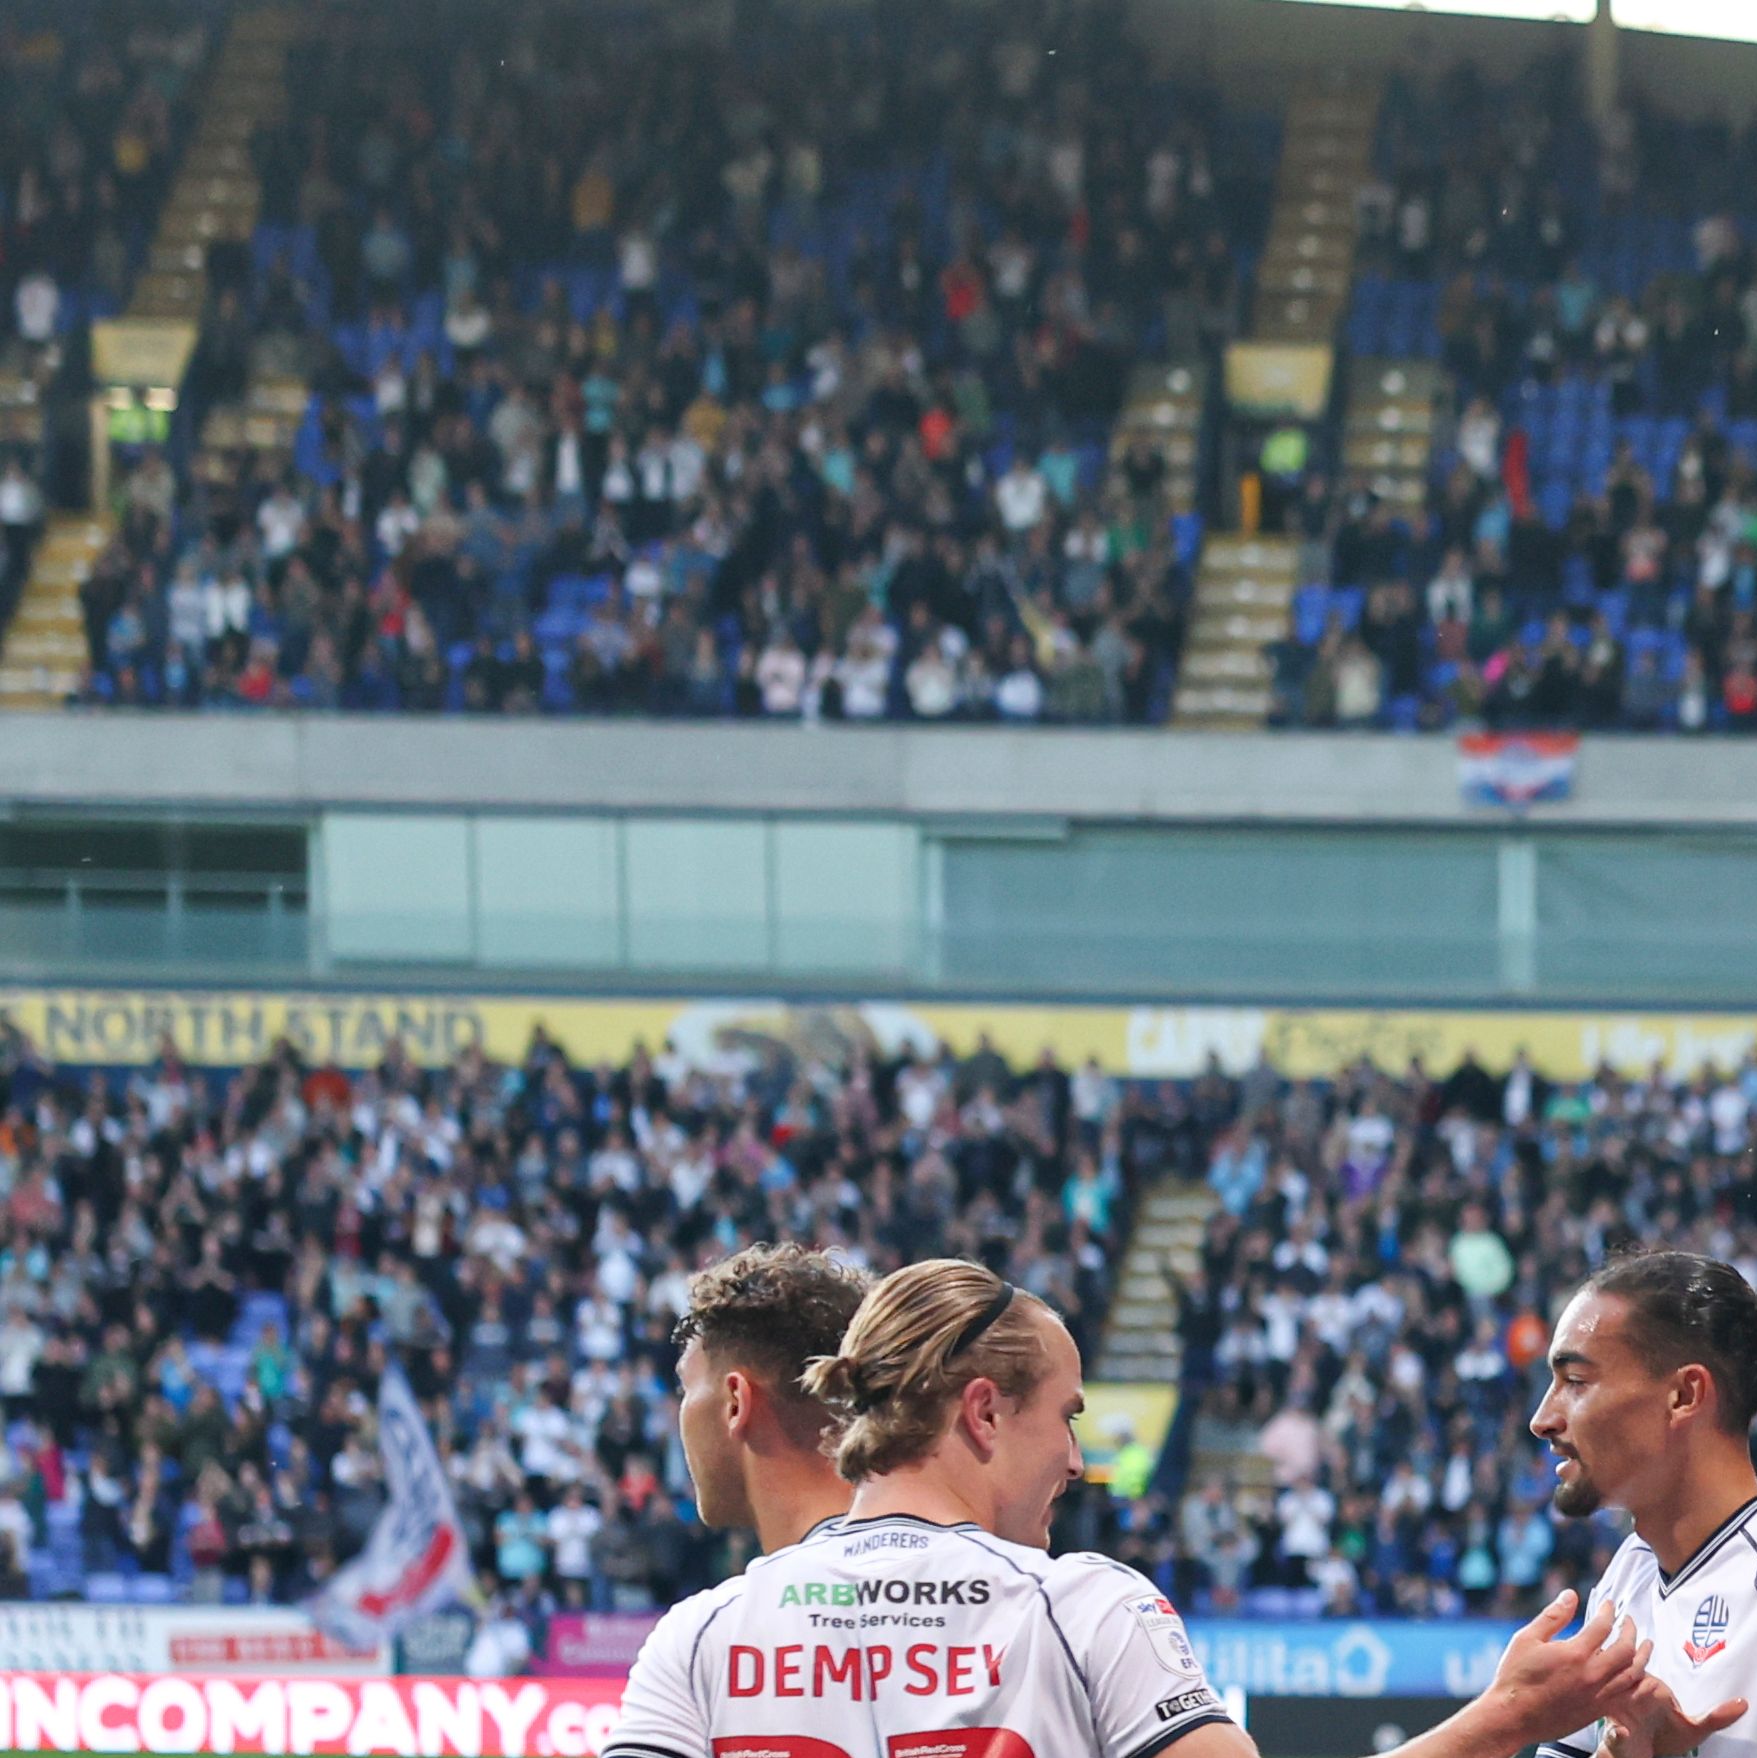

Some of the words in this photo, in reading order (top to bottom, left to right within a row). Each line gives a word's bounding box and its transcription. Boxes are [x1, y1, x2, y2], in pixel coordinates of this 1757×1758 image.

[44, 1002, 264, 1045] NORTH
[290, 1004, 486, 1048] STAND
[844, 1531, 929, 1557] WANDERERS
[808, 1613, 855, 1629] Tree
[859, 1611, 946, 1629] Services
[728, 1642, 1007, 1702] DEMPSEY
